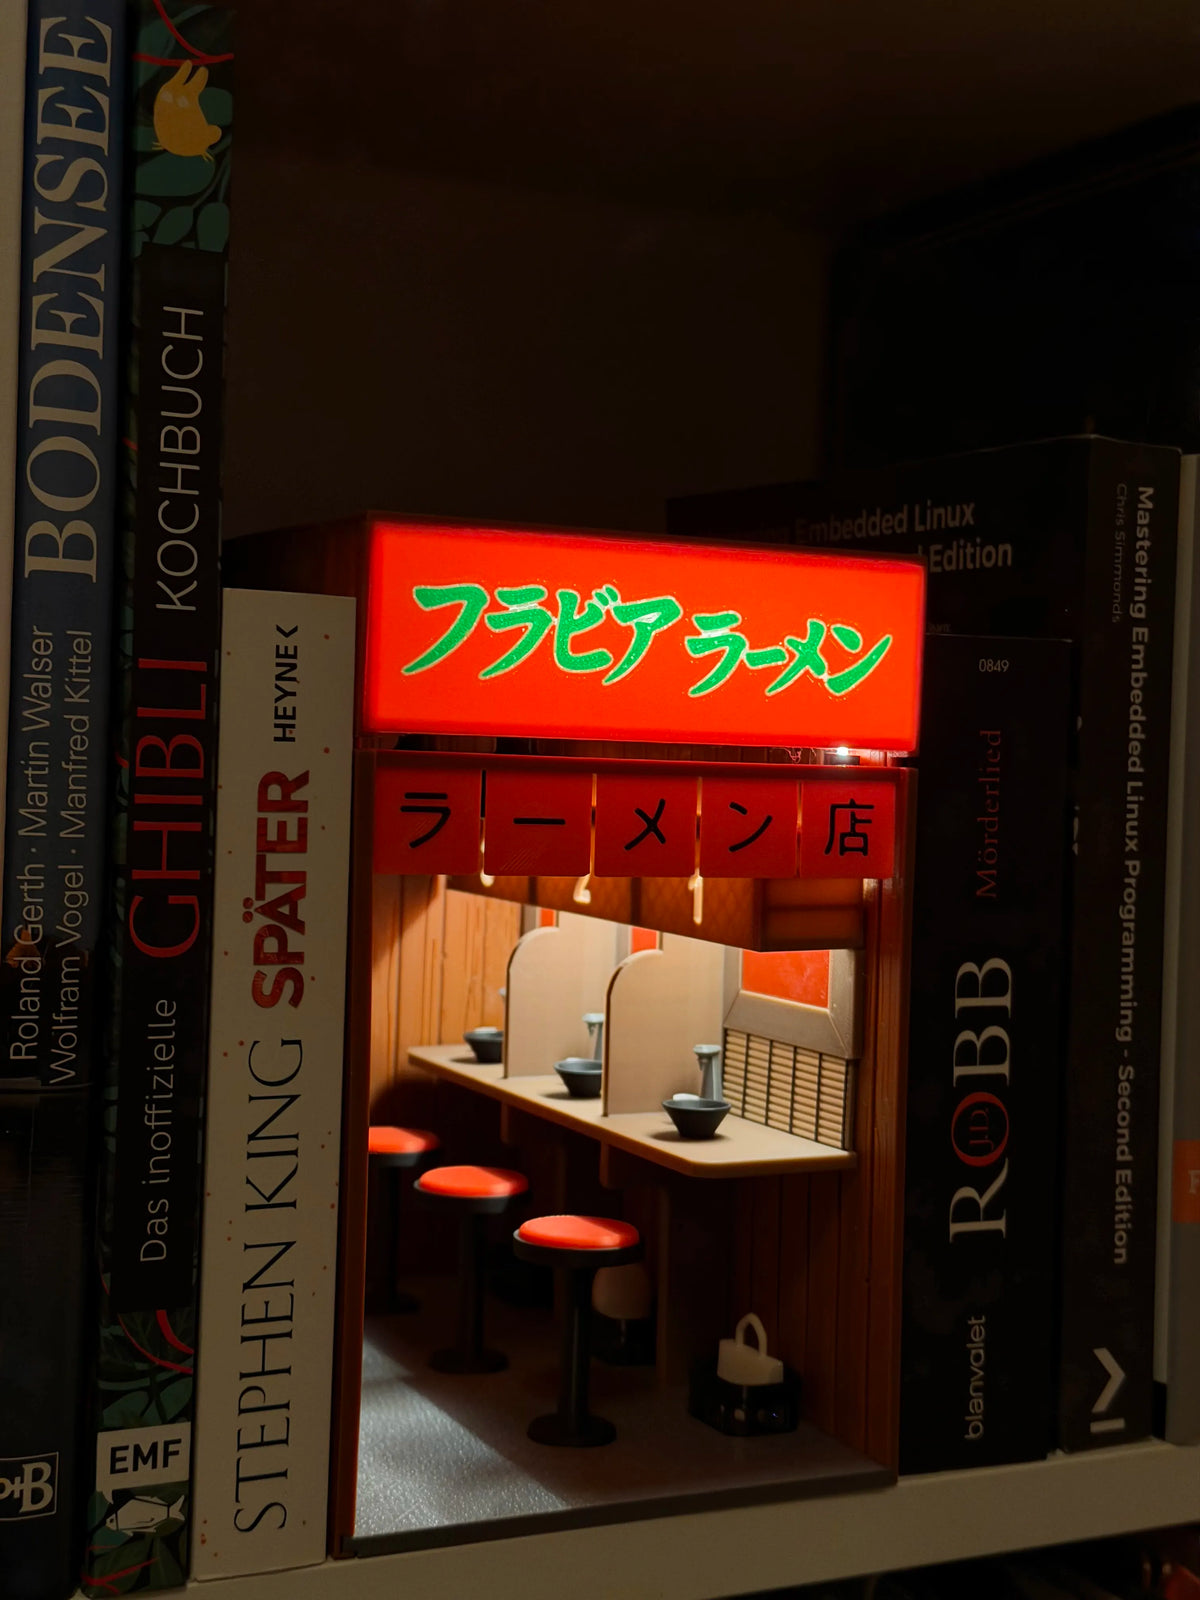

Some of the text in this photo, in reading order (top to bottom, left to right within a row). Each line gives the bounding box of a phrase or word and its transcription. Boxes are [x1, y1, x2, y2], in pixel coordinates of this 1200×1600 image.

[24, 16, 112, 583] BODENSEE
[795, 504, 908, 544] Embedded
[914, 500, 976, 532] Linux
[929, 537, 1013, 573] Edition
[1112, 483, 1127, 623] Chris Simmonds
[1129, 486, 1155, 619] Mastering
[21, 625, 53, 731] Walser
[64, 630, 92, 703] Kittel
[400, 583, 893, 696] フラビア ラーメン
[978, 658, 1010, 673] 0849
[1127, 627, 1149, 773] Embedded
[17, 741, 50, 837] Martin
[59, 715, 89, 838] Manfred
[129, 305, 207, 1262] Das inoffizielle GHIBLI KOCHBUCH
[400, 791, 875, 857] ラーメン店
[975, 729, 1002, 899] Mörderlied
[1124, 781, 1145, 852] Linux
[14, 864, 45, 945] Gerth
[55, 865, 89, 948] Vogel
[242, 770, 310, 1009] SPÄTER
[1115, 859, 1141, 1042] Programming
[9, 957, 42, 1060] Roland
[49, 957, 80, 1084] Wolfram
[949, 957, 1012, 1244] ROBB
[1115, 1064, 1135, 1162] Second
[1113, 1168, 1133, 1264] Edition
[233, 1039, 302, 1532] STEPHEN KING
[964, 1314, 987, 1440] blanvalet
[109, 1439, 182, 1475] EMF
